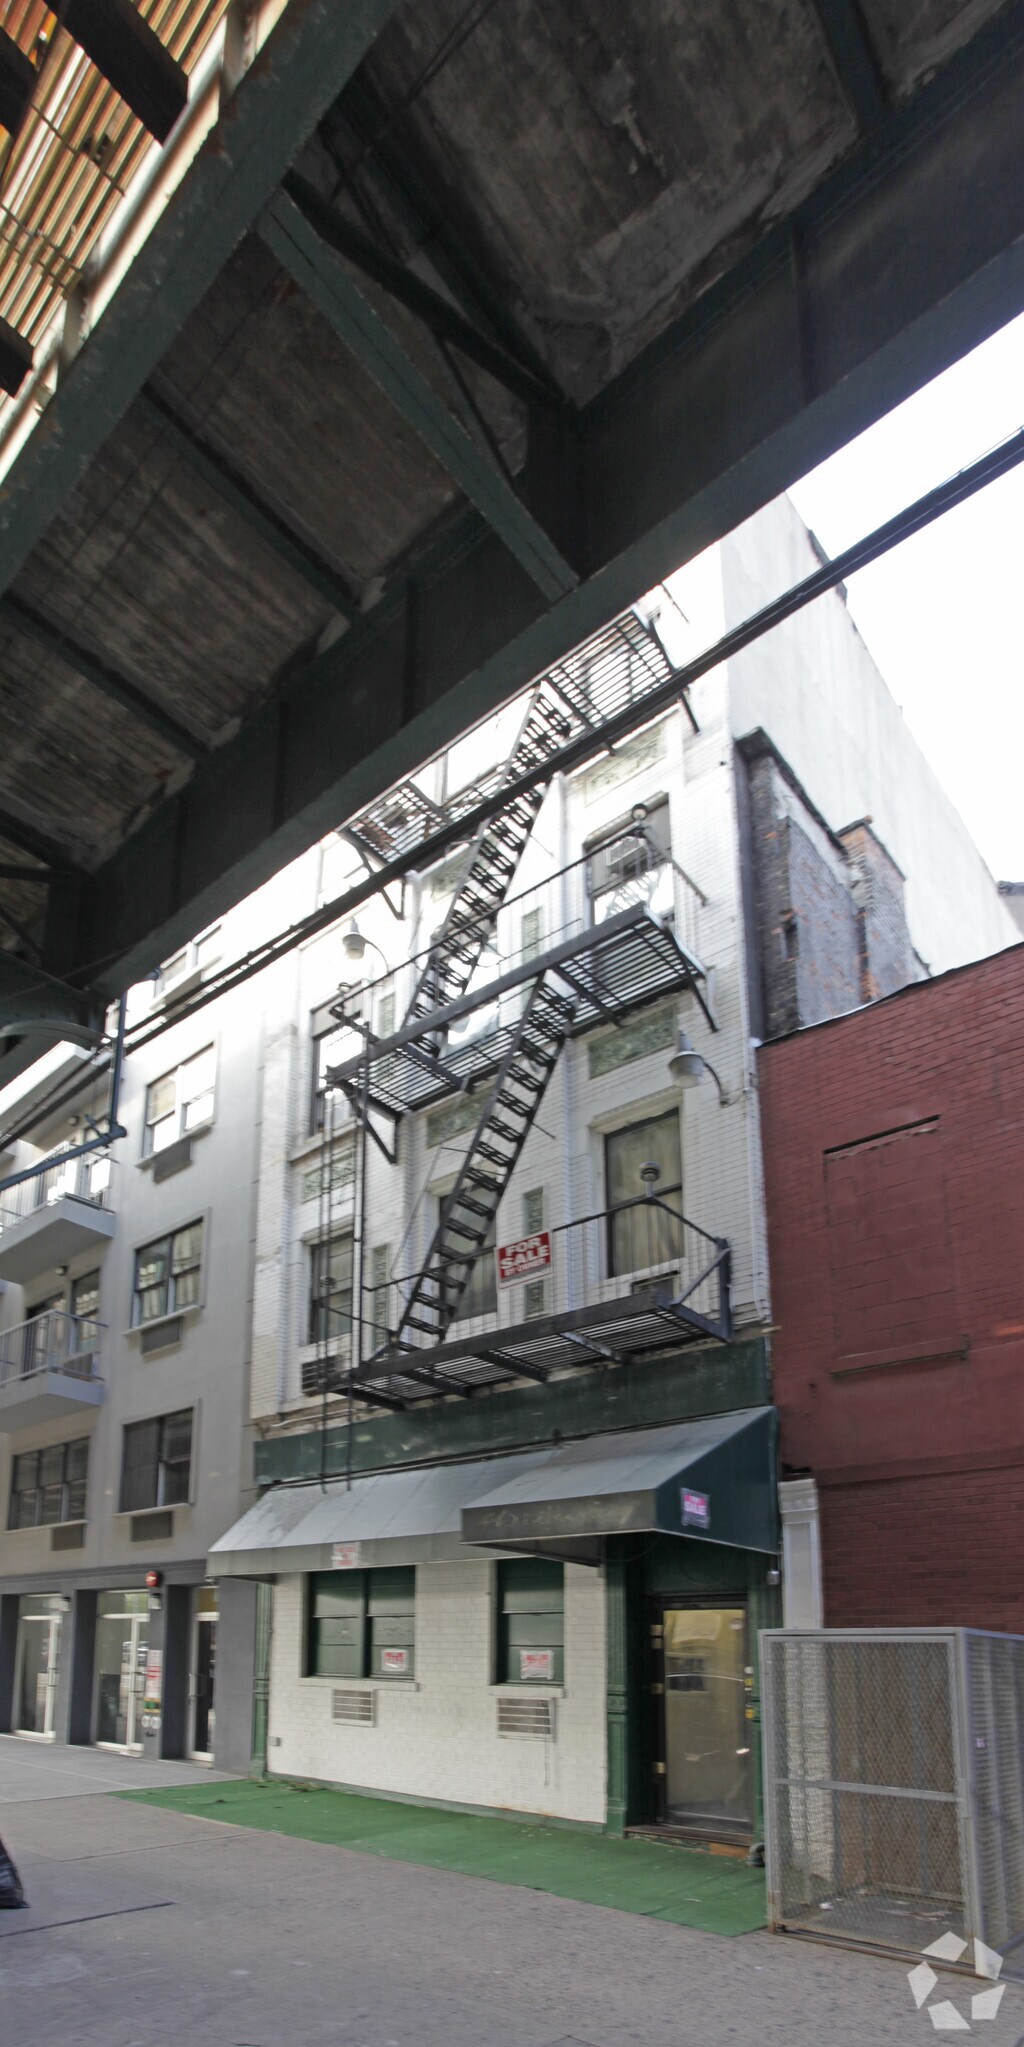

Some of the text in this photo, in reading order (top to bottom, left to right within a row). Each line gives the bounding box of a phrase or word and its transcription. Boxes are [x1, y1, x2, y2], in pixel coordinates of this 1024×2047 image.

[505, 1237, 542, 1257] FOR
[500, 1245, 550, 1270] SALE
[683, 1501, 707, 1516] SALE
